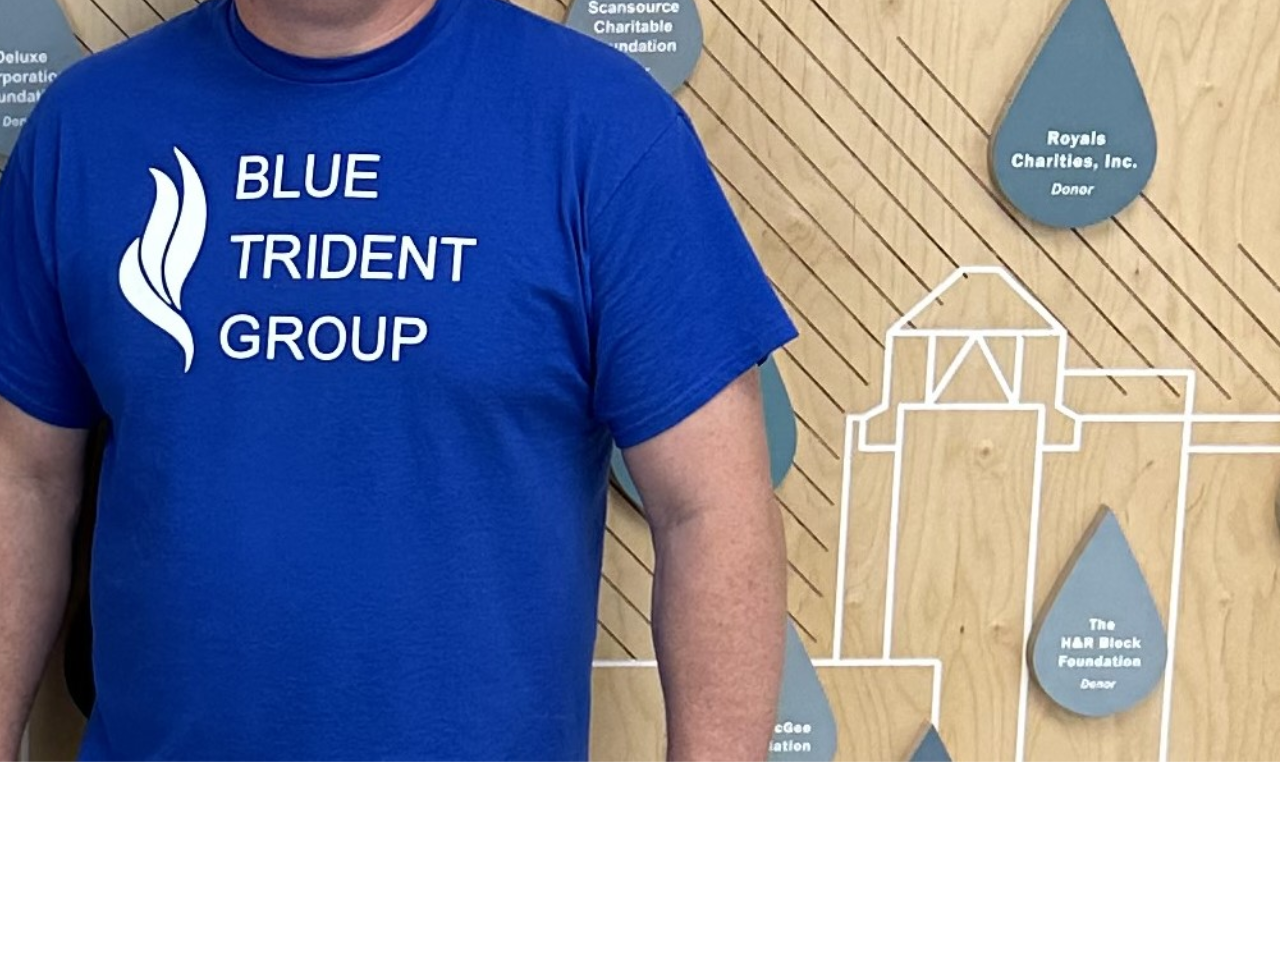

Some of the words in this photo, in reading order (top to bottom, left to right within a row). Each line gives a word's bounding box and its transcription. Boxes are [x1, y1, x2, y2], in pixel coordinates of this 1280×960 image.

[587, 0, 680, 15] Scansource
[593, 19, 673, 35] Charitable
[1046, 130, 1107, 148] Royals
[1011, 153, 1099, 171] Charities,
[1104, 153, 1138, 169] Inc.
[235, 153, 381, 200] BLUE
[1050, 182, 1096, 196] Donor
[230, 233, 477, 282] TRIDENT
[219, 313, 428, 362] GROUP
[1088, 618, 1116, 631] The
[1098, 636, 1142, 649] Block
[1058, 655, 1142, 668] Foundation
[1080, 678, 1117, 690] Donor
[774, 721, 812, 734] cGee
